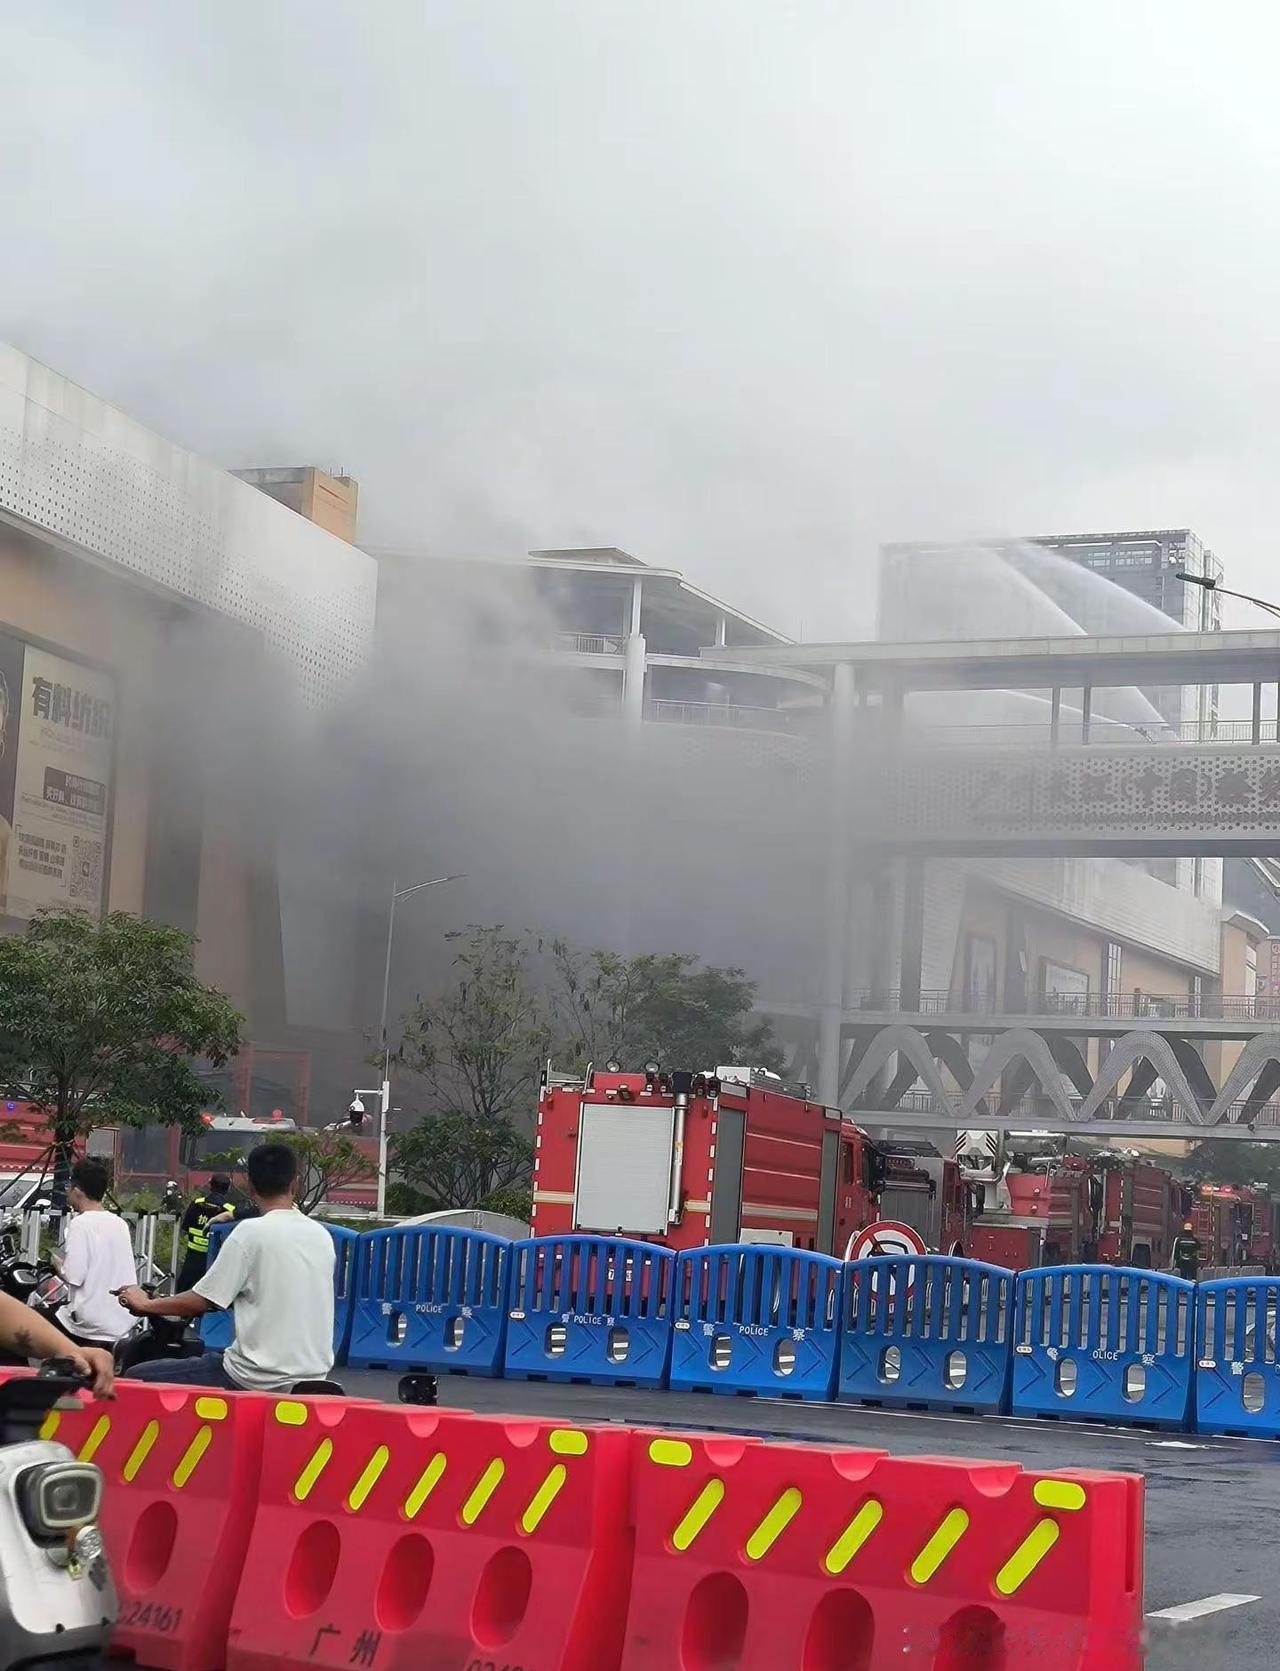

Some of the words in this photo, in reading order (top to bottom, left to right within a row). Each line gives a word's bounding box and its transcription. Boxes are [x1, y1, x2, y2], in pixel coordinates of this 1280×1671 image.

[416, 1304, 443, 1313] POLICE
[574, 1315, 602, 1325] POLICE
[703, 1323, 714, 1336] 警
[739, 1325, 769, 1336] POLICE
[792, 1328, 805, 1341] 察
[1092, 1350, 1119, 1361] OLICE
[1142, 1353, 1155, 1366] 察
[1231, 1361, 1244, 1375] 警
[310, 1624, 382, 1668] 广州
